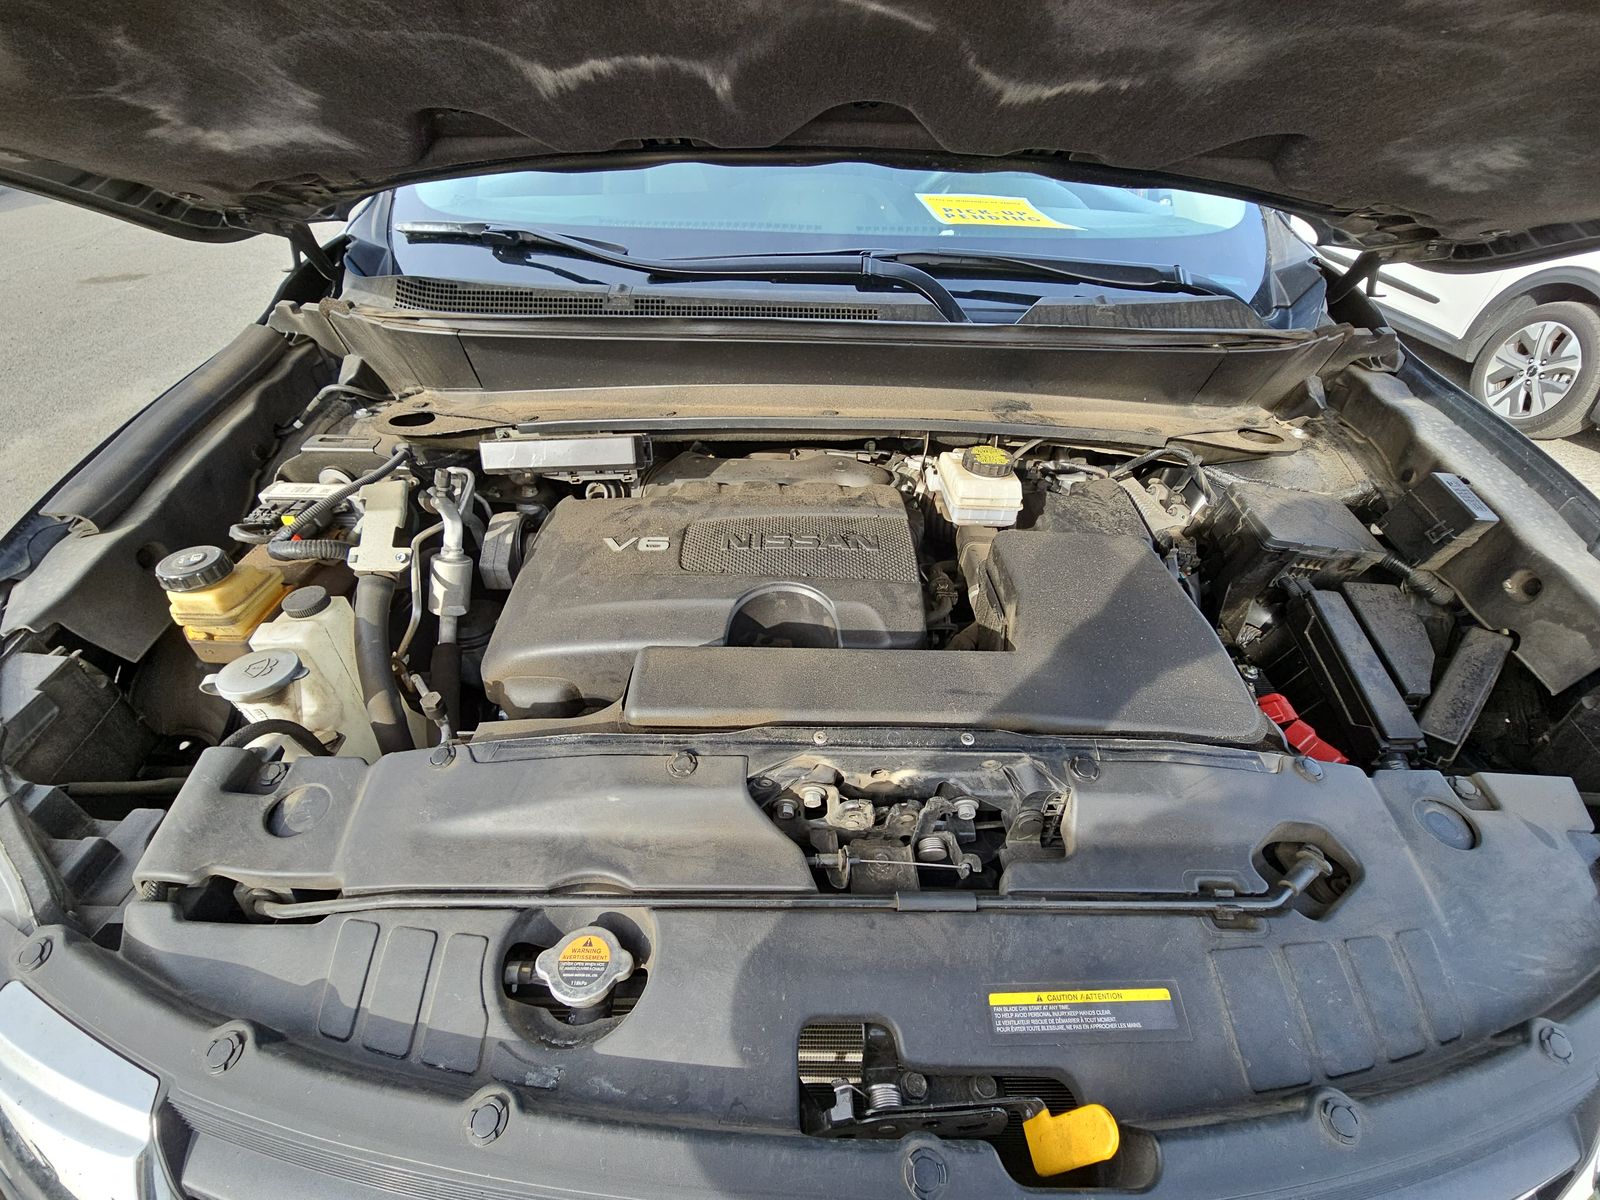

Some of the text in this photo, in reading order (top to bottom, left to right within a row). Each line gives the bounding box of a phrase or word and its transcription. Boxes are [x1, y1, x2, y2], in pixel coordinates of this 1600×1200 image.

[942, 207, 1027, 215] PICK-UP
[944, 213, 1041, 222] PENDING
[603, 536, 670, 552] V6
[722, 532, 880, 551] NISSAN
[1085, 992, 1123, 1000] ATTENTION
